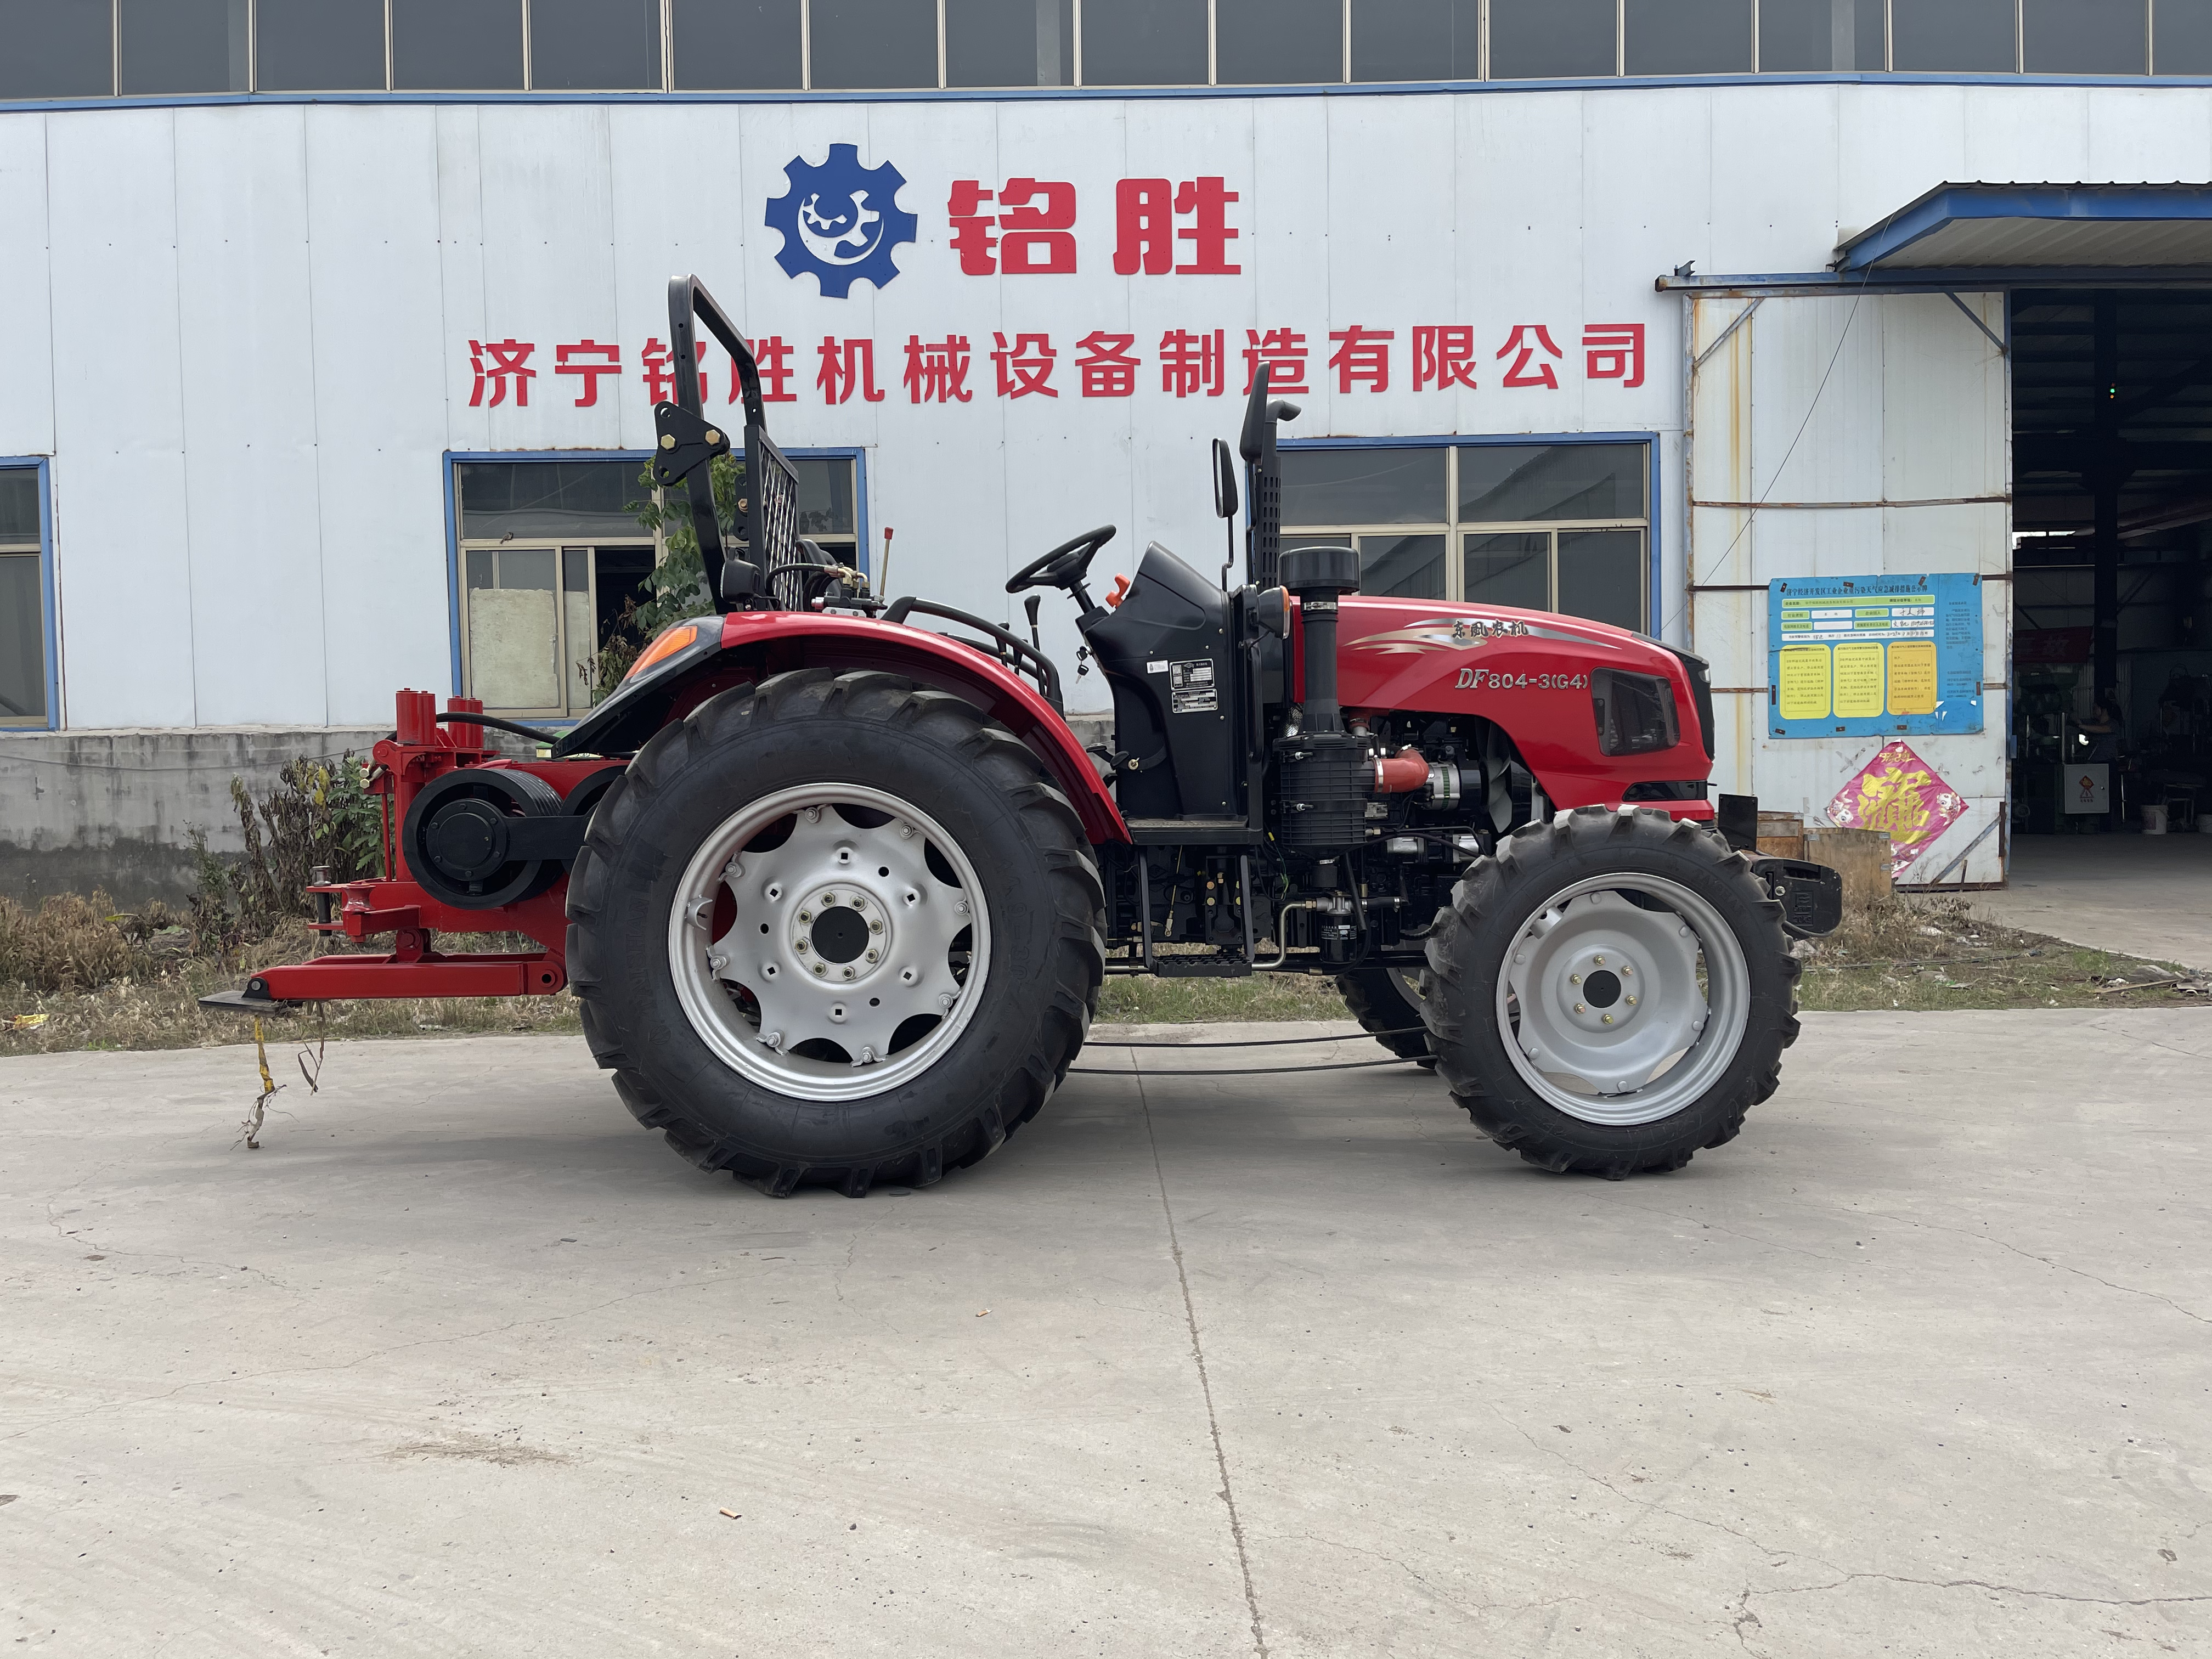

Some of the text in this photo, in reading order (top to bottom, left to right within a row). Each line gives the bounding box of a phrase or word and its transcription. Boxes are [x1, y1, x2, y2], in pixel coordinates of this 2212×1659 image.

[947, 177, 1241, 275] 铭胜
[469, 323, 1645, 407] 济宁铭胜机械设备制造有限公司
[1454, 668, 1588, 690] DF804-3(G4)
[625, 895, 657, 1018] TAISHAN
